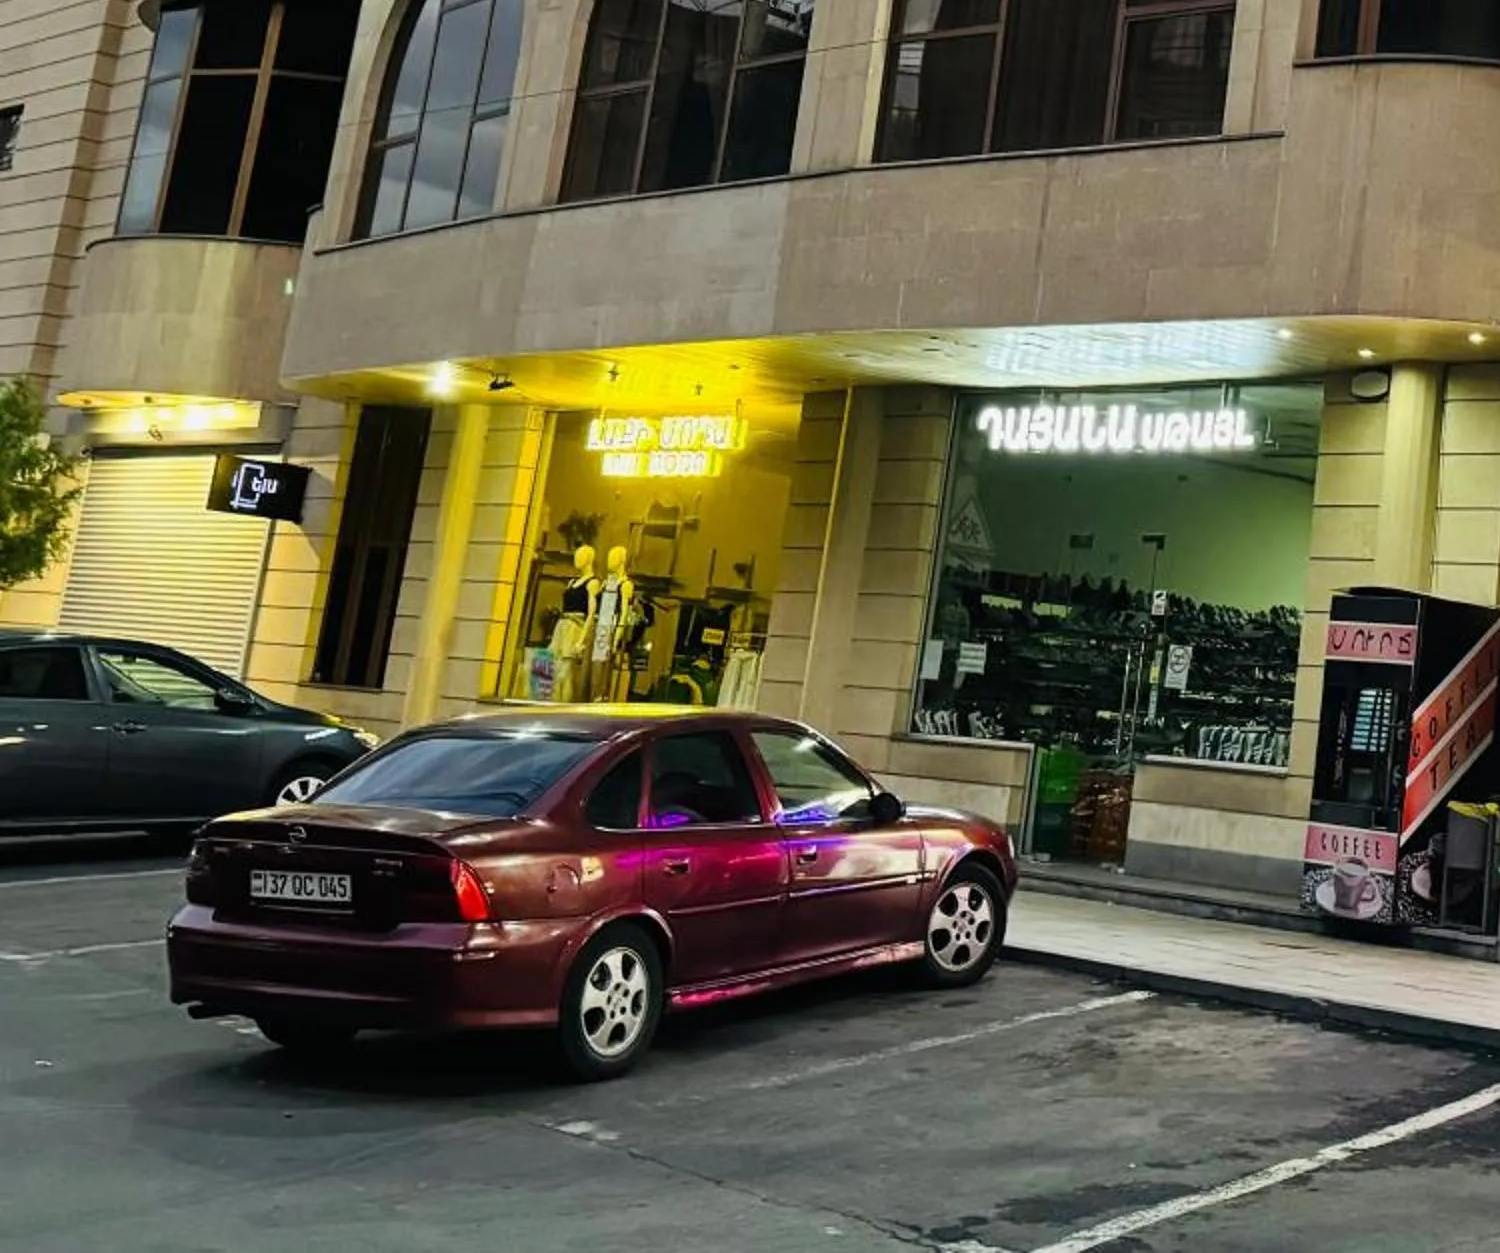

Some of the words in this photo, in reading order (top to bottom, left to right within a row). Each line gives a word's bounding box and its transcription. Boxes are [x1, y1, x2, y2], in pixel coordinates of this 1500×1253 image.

[976, 404, 1137, 452] ԴԱՅԱՆԱ
[1329, 628, 1412, 655] ՍՈՒՐՃ
[1429, 720, 1476, 790] TEA
[1320, 832, 1383, 861] COFFEE
[268, 873, 288, 896] 37
[318, 876, 348, 899] 045
